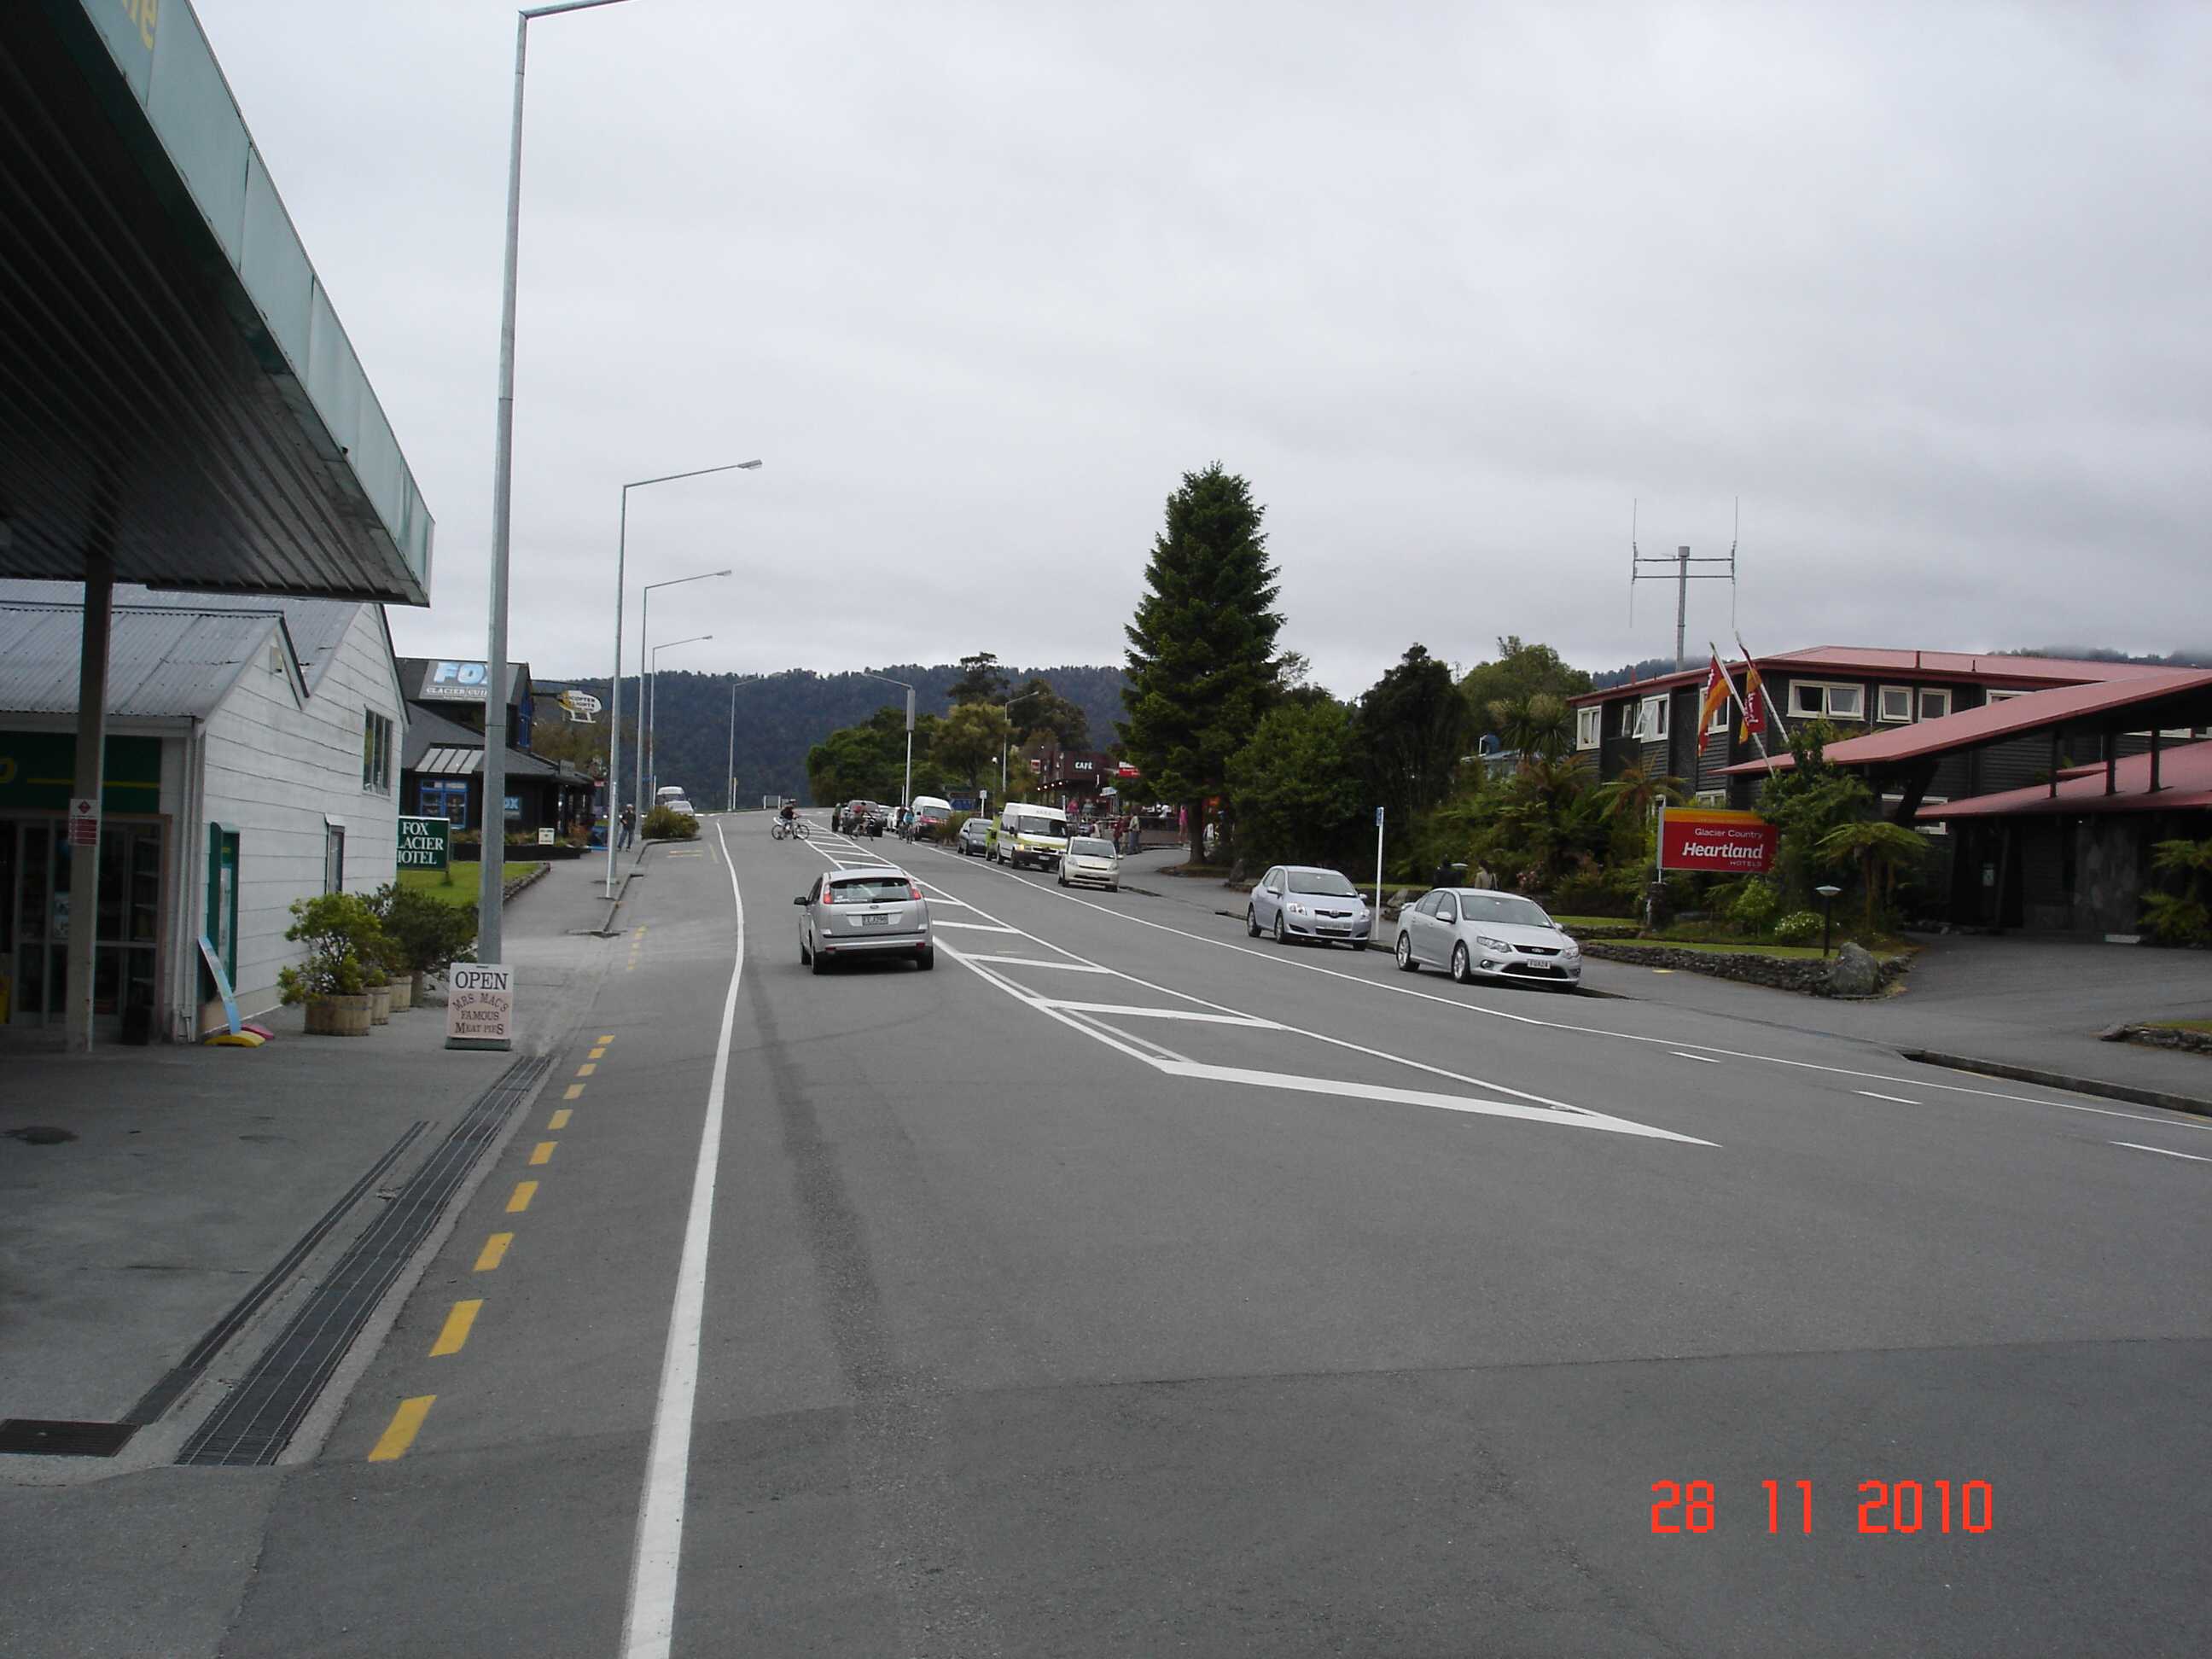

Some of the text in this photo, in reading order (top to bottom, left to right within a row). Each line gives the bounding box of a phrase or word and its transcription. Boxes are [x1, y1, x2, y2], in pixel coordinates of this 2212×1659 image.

[403, 822, 428, 835] FOX
[1695, 828, 1762, 839] Glacier Country
[397, 837, 444, 851] LACIER
[1682, 841, 1764, 859] Heartland
[455, 971, 509, 990] OPEN
[452, 992, 474, 1011] MRS
[461, 1010, 499, 1021] FAMOUS
[455, 1022, 504, 1035] MEAT PIES
